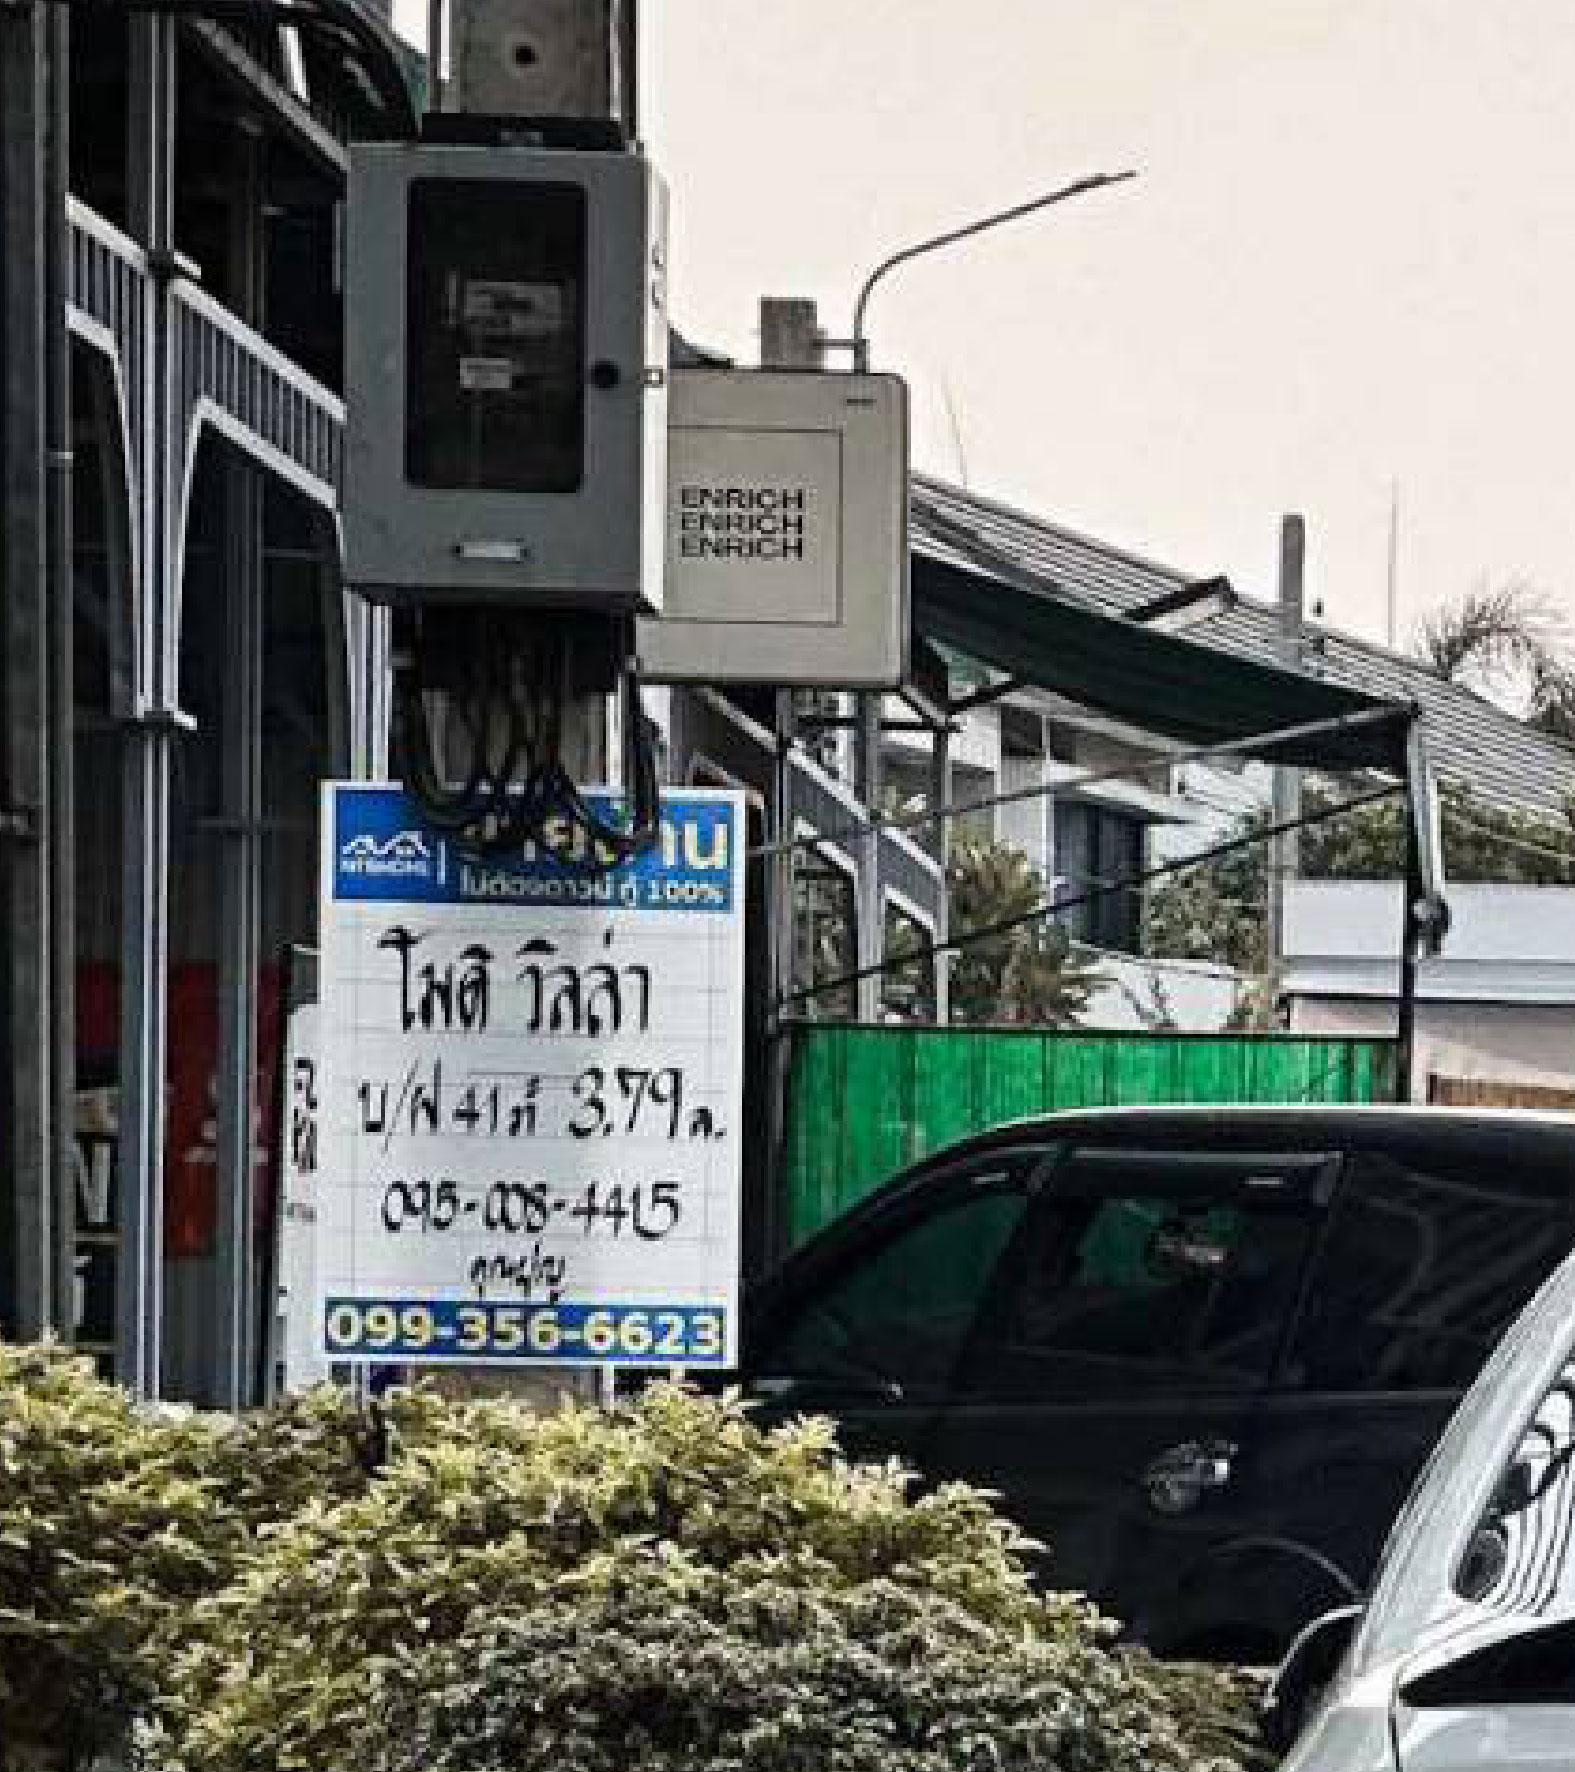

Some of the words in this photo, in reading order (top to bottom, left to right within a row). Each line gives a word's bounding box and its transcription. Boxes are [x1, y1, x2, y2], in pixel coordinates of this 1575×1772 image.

[681, 487, 803, 509] ENRICH
[681, 512, 803, 534] ENRICH
[681, 535, 803, 560] ENRICH
[648, 879, 725, 905] 100%
[328, 1304, 724, 1354] 099-356-6623
